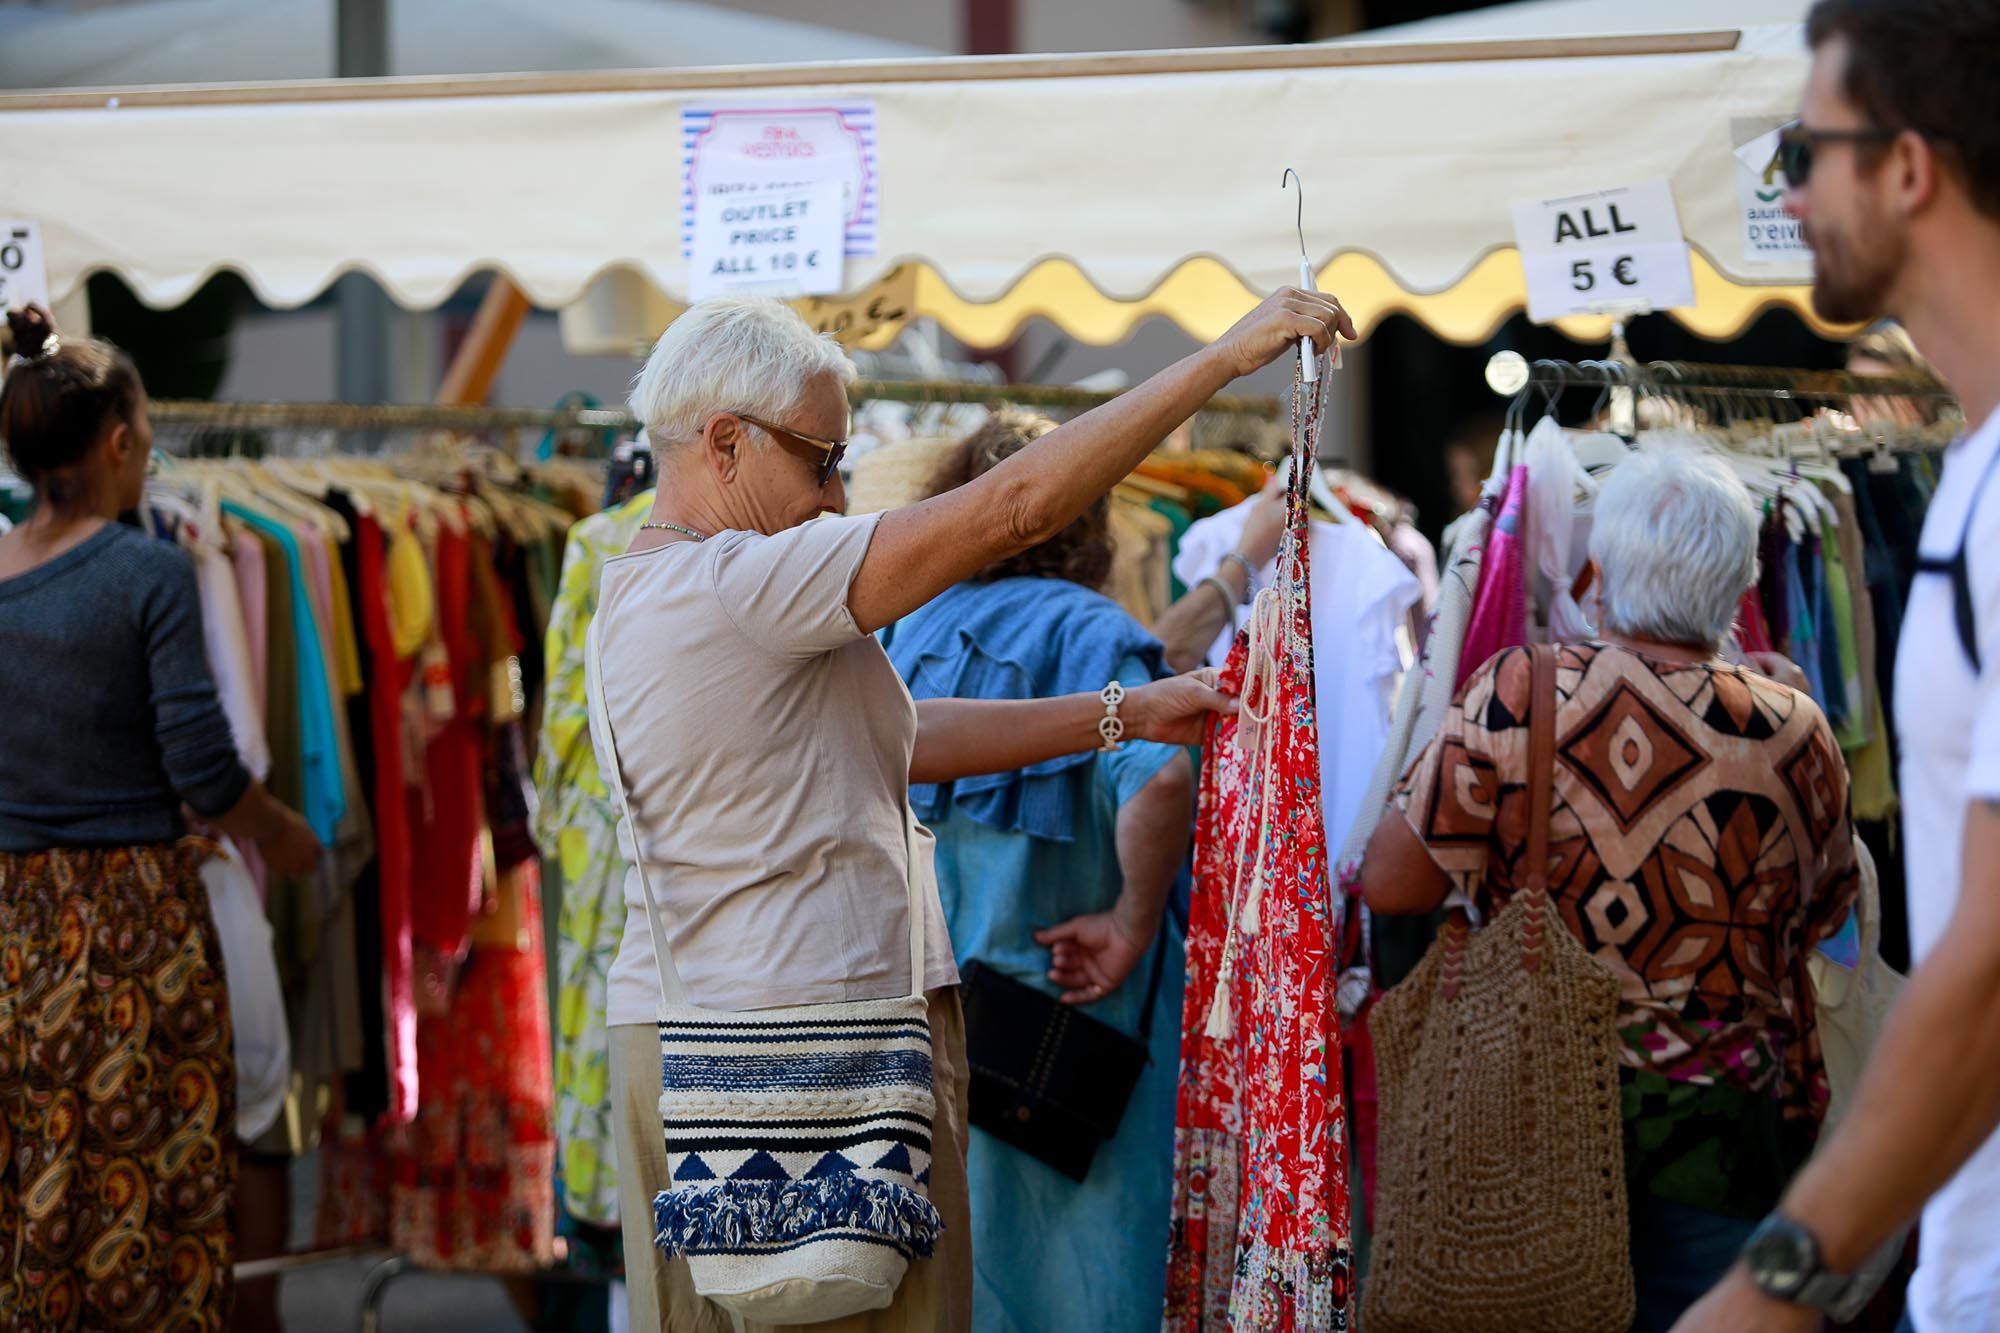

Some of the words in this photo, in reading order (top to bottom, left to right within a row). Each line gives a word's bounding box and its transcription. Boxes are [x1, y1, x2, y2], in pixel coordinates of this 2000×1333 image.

[721, 200, 809, 223] OUTLET
[1555, 203, 1636, 243] ALL
[730, 226, 797, 245] PRICE
[712, 255, 758, 275] ALL
[770, 252, 798, 269] 10
[805, 249, 820, 267] €
[1572, 260, 1595, 291] 5
[1611, 256, 1637, 286] €
